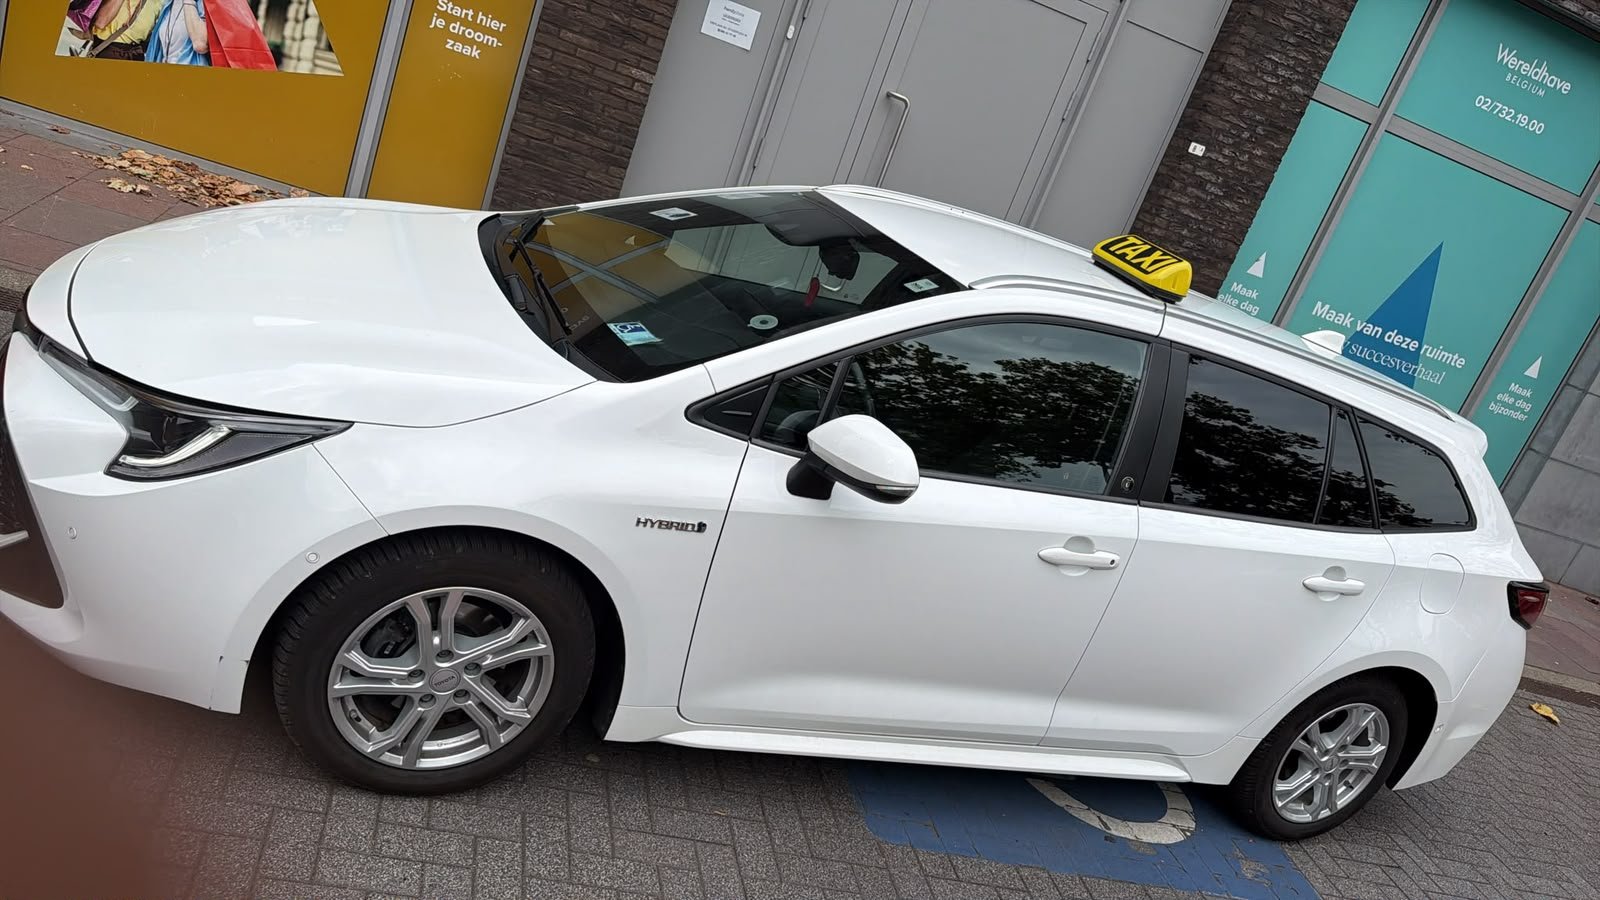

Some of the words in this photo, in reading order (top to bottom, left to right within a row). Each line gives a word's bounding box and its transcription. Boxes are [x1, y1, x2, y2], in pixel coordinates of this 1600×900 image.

[437, 0, 474, 21] Start
[477, 12, 507, 32] hier
[429, 13, 446, 28] je
[449, 21, 503, 48] droom-
[445, 39, 481, 59] zaak
[1496, 43, 1572, 95] Wereldhave
[1505, 72, 1546, 98] BELGIUM
[1475, 95, 1545, 135] 02/732.19.00
[1108, 236, 1179, 273] TAXI
[1230, 282, 1259, 300] Maak
[1217, 294, 1239, 307] elke
[1240, 301, 1260, 316] dag
[1312, 301, 1355, 328] Maak
[1356, 319, 1383, 339] van
[1384, 329, 1420, 352] deze
[1420, 344, 1466, 369] ruimte
[1348, 342, 1446, 385] succesverhaal
[1508, 382, 1533, 398] Maak
[1489, 401, 1529, 422] bijzonder
[1496, 393, 1515, 405] elke
[1515, 399, 1532, 412] dag
[635, 517, 698, 533] HYBRID
[434, 675, 456, 688] TOYOTA
